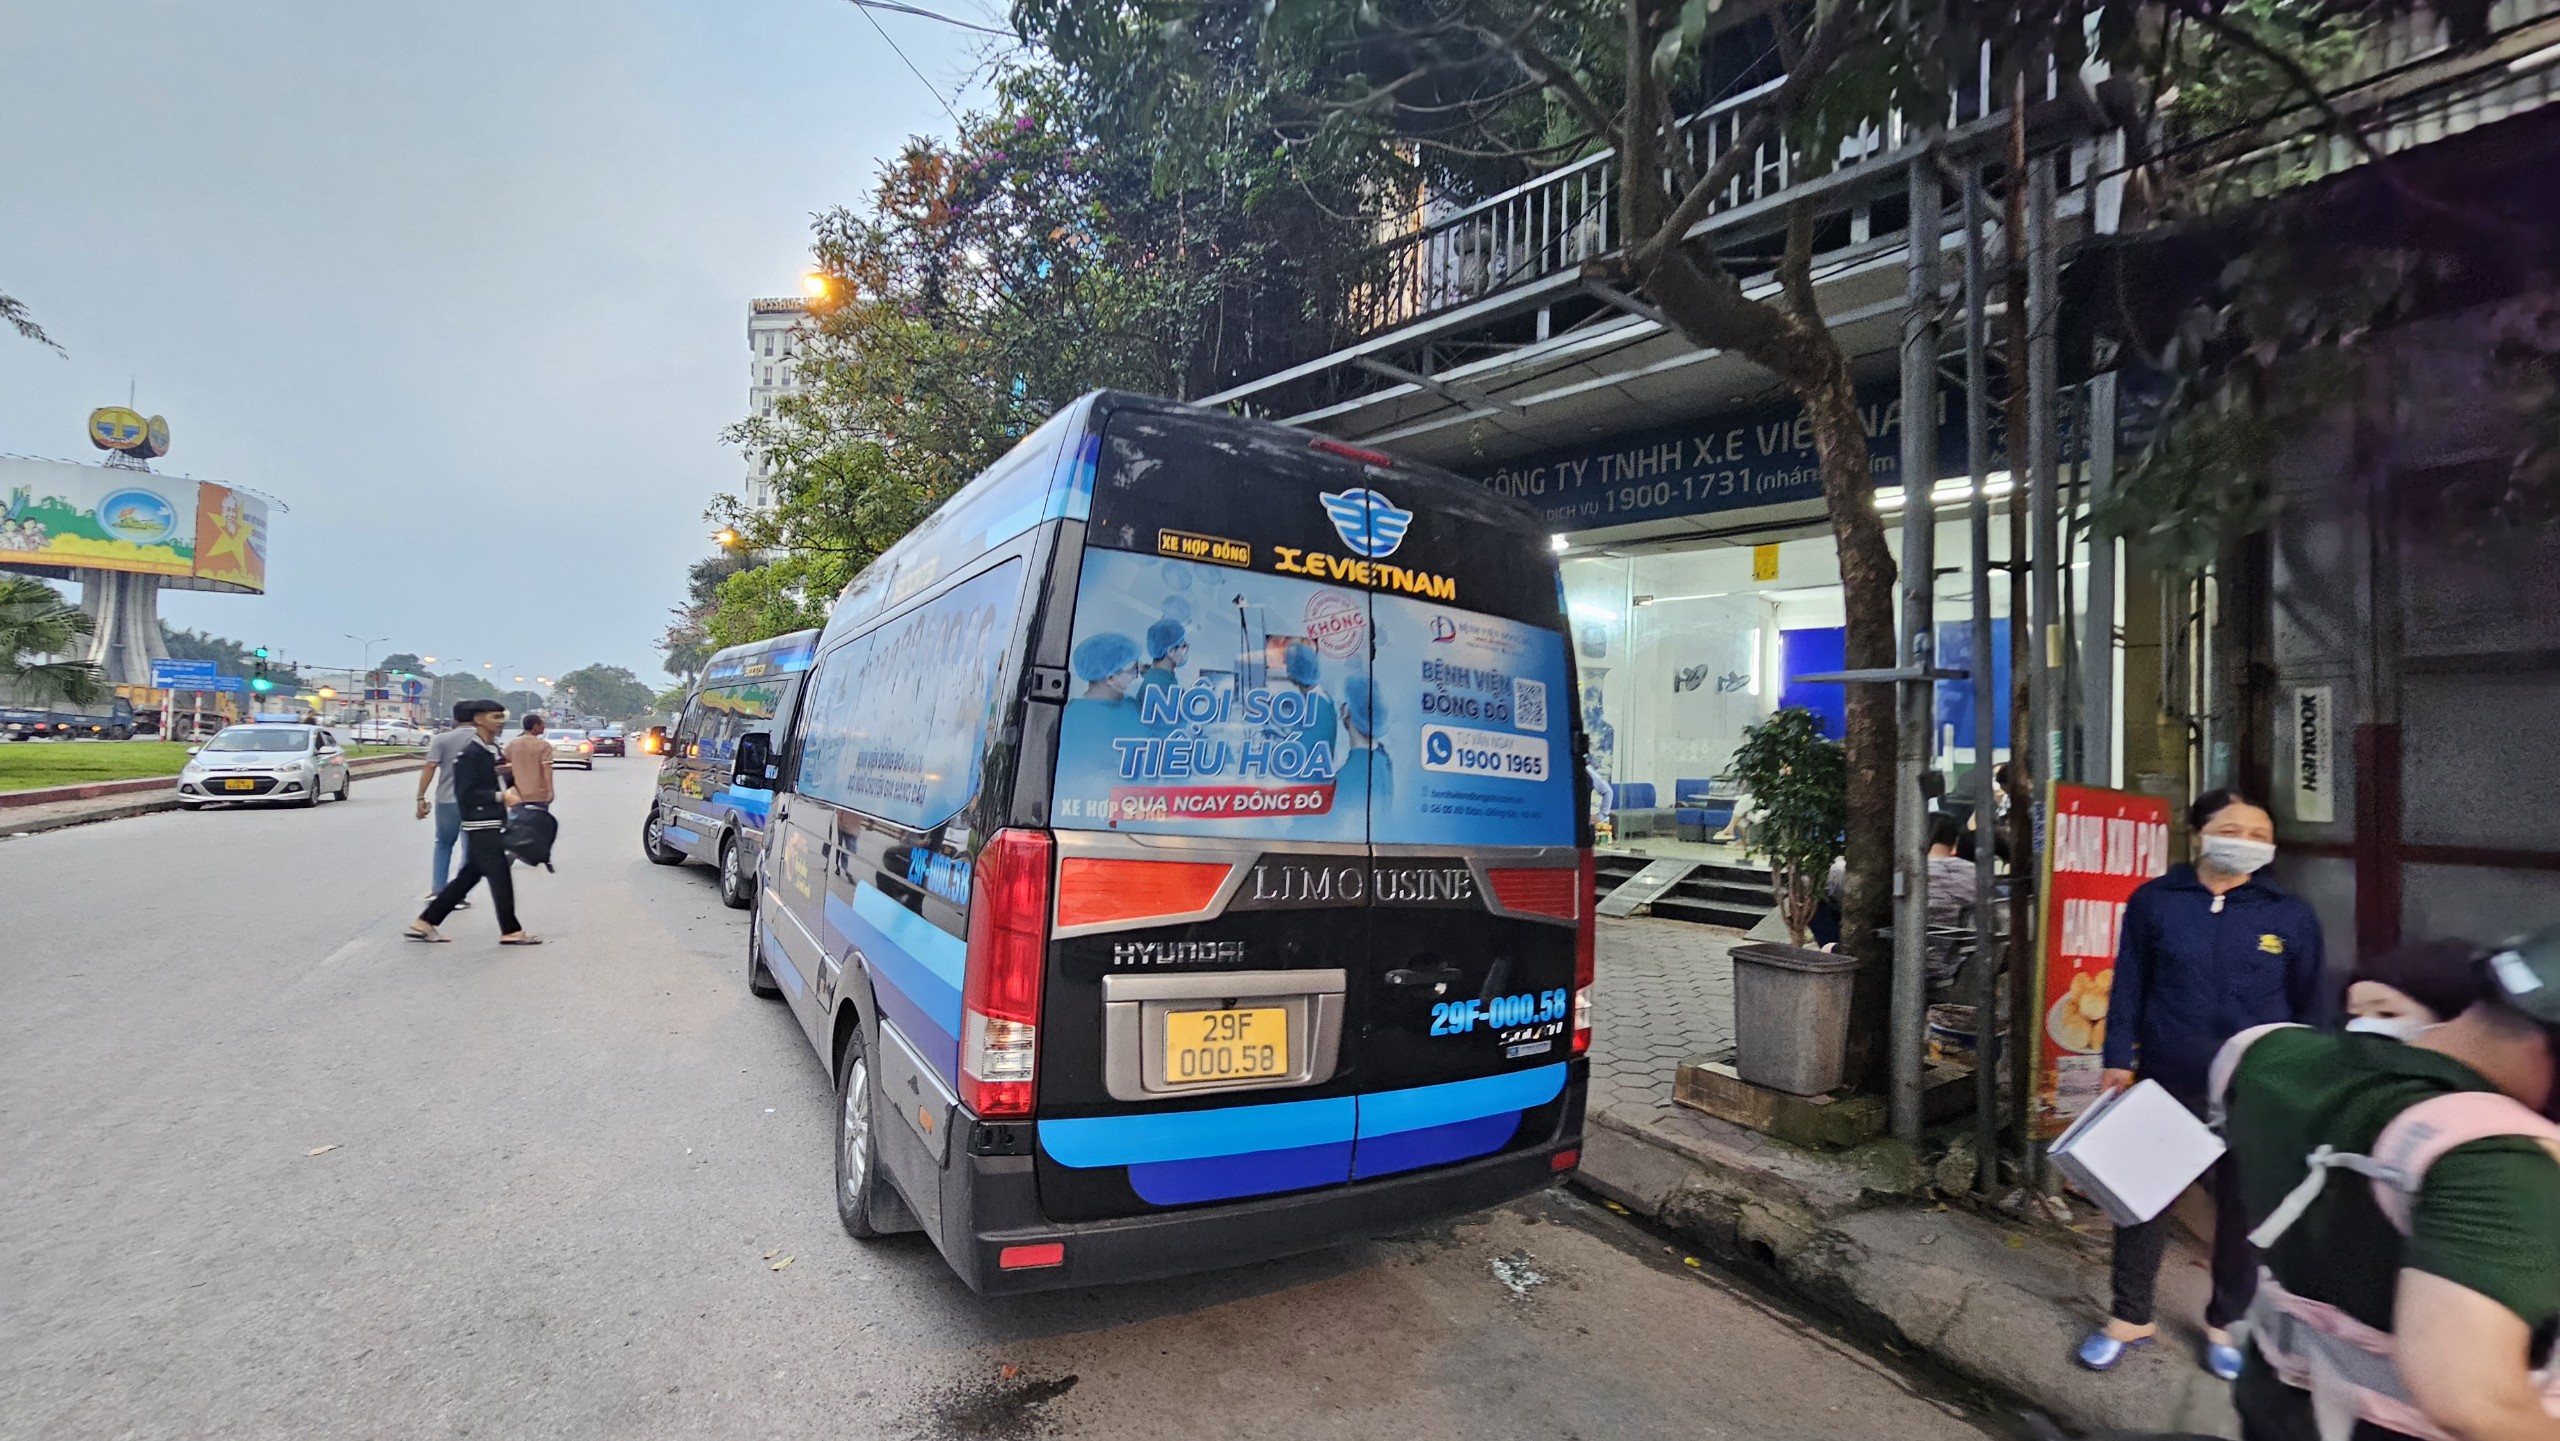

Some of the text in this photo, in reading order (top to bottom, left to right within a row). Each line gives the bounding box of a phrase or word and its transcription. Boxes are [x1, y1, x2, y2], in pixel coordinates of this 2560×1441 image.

[1554, 459, 1589, 491] TY
[1597, 442, 1681, 483] TNHH
[1692, 430, 1744, 466] X.E
[1756, 406, 1816, 459] VIỆ
[1607, 468, 1750, 513] 1900-1731
[1756, 462, 1820, 493] (nhán
[1161, 534, 1248, 562] XE HỢP ĐỒNG
[1422, 658, 1512, 698] BỆNH VIỆN
[1141, 676, 1319, 735] NỘI SOI
[1422, 689, 1509, 722] ĐÔNG ĐÔ
[1112, 728, 1336, 779] TIÊU HÓA
[1456, 748, 1542, 775] 1900 1965
[1061, 799, 1080, 816] XE
[1086, 799, 1118, 820] HỢP
[1120, 790, 1322, 814] QUA NGAY ĐÔNG ĐÔ
[2053, 800, 2104, 873] BÁNH
[907, 847, 972, 905] 29F-000.58
[1252, 865, 1472, 901] LIMOUSINE
[1114, 941, 1245, 965] HYUNDAI
[1203, 1013, 1253, 1042] 29F
[1430, 987, 1567, 1036] 29F-000.58
[1181, 1045, 1274, 1077] 000.58
